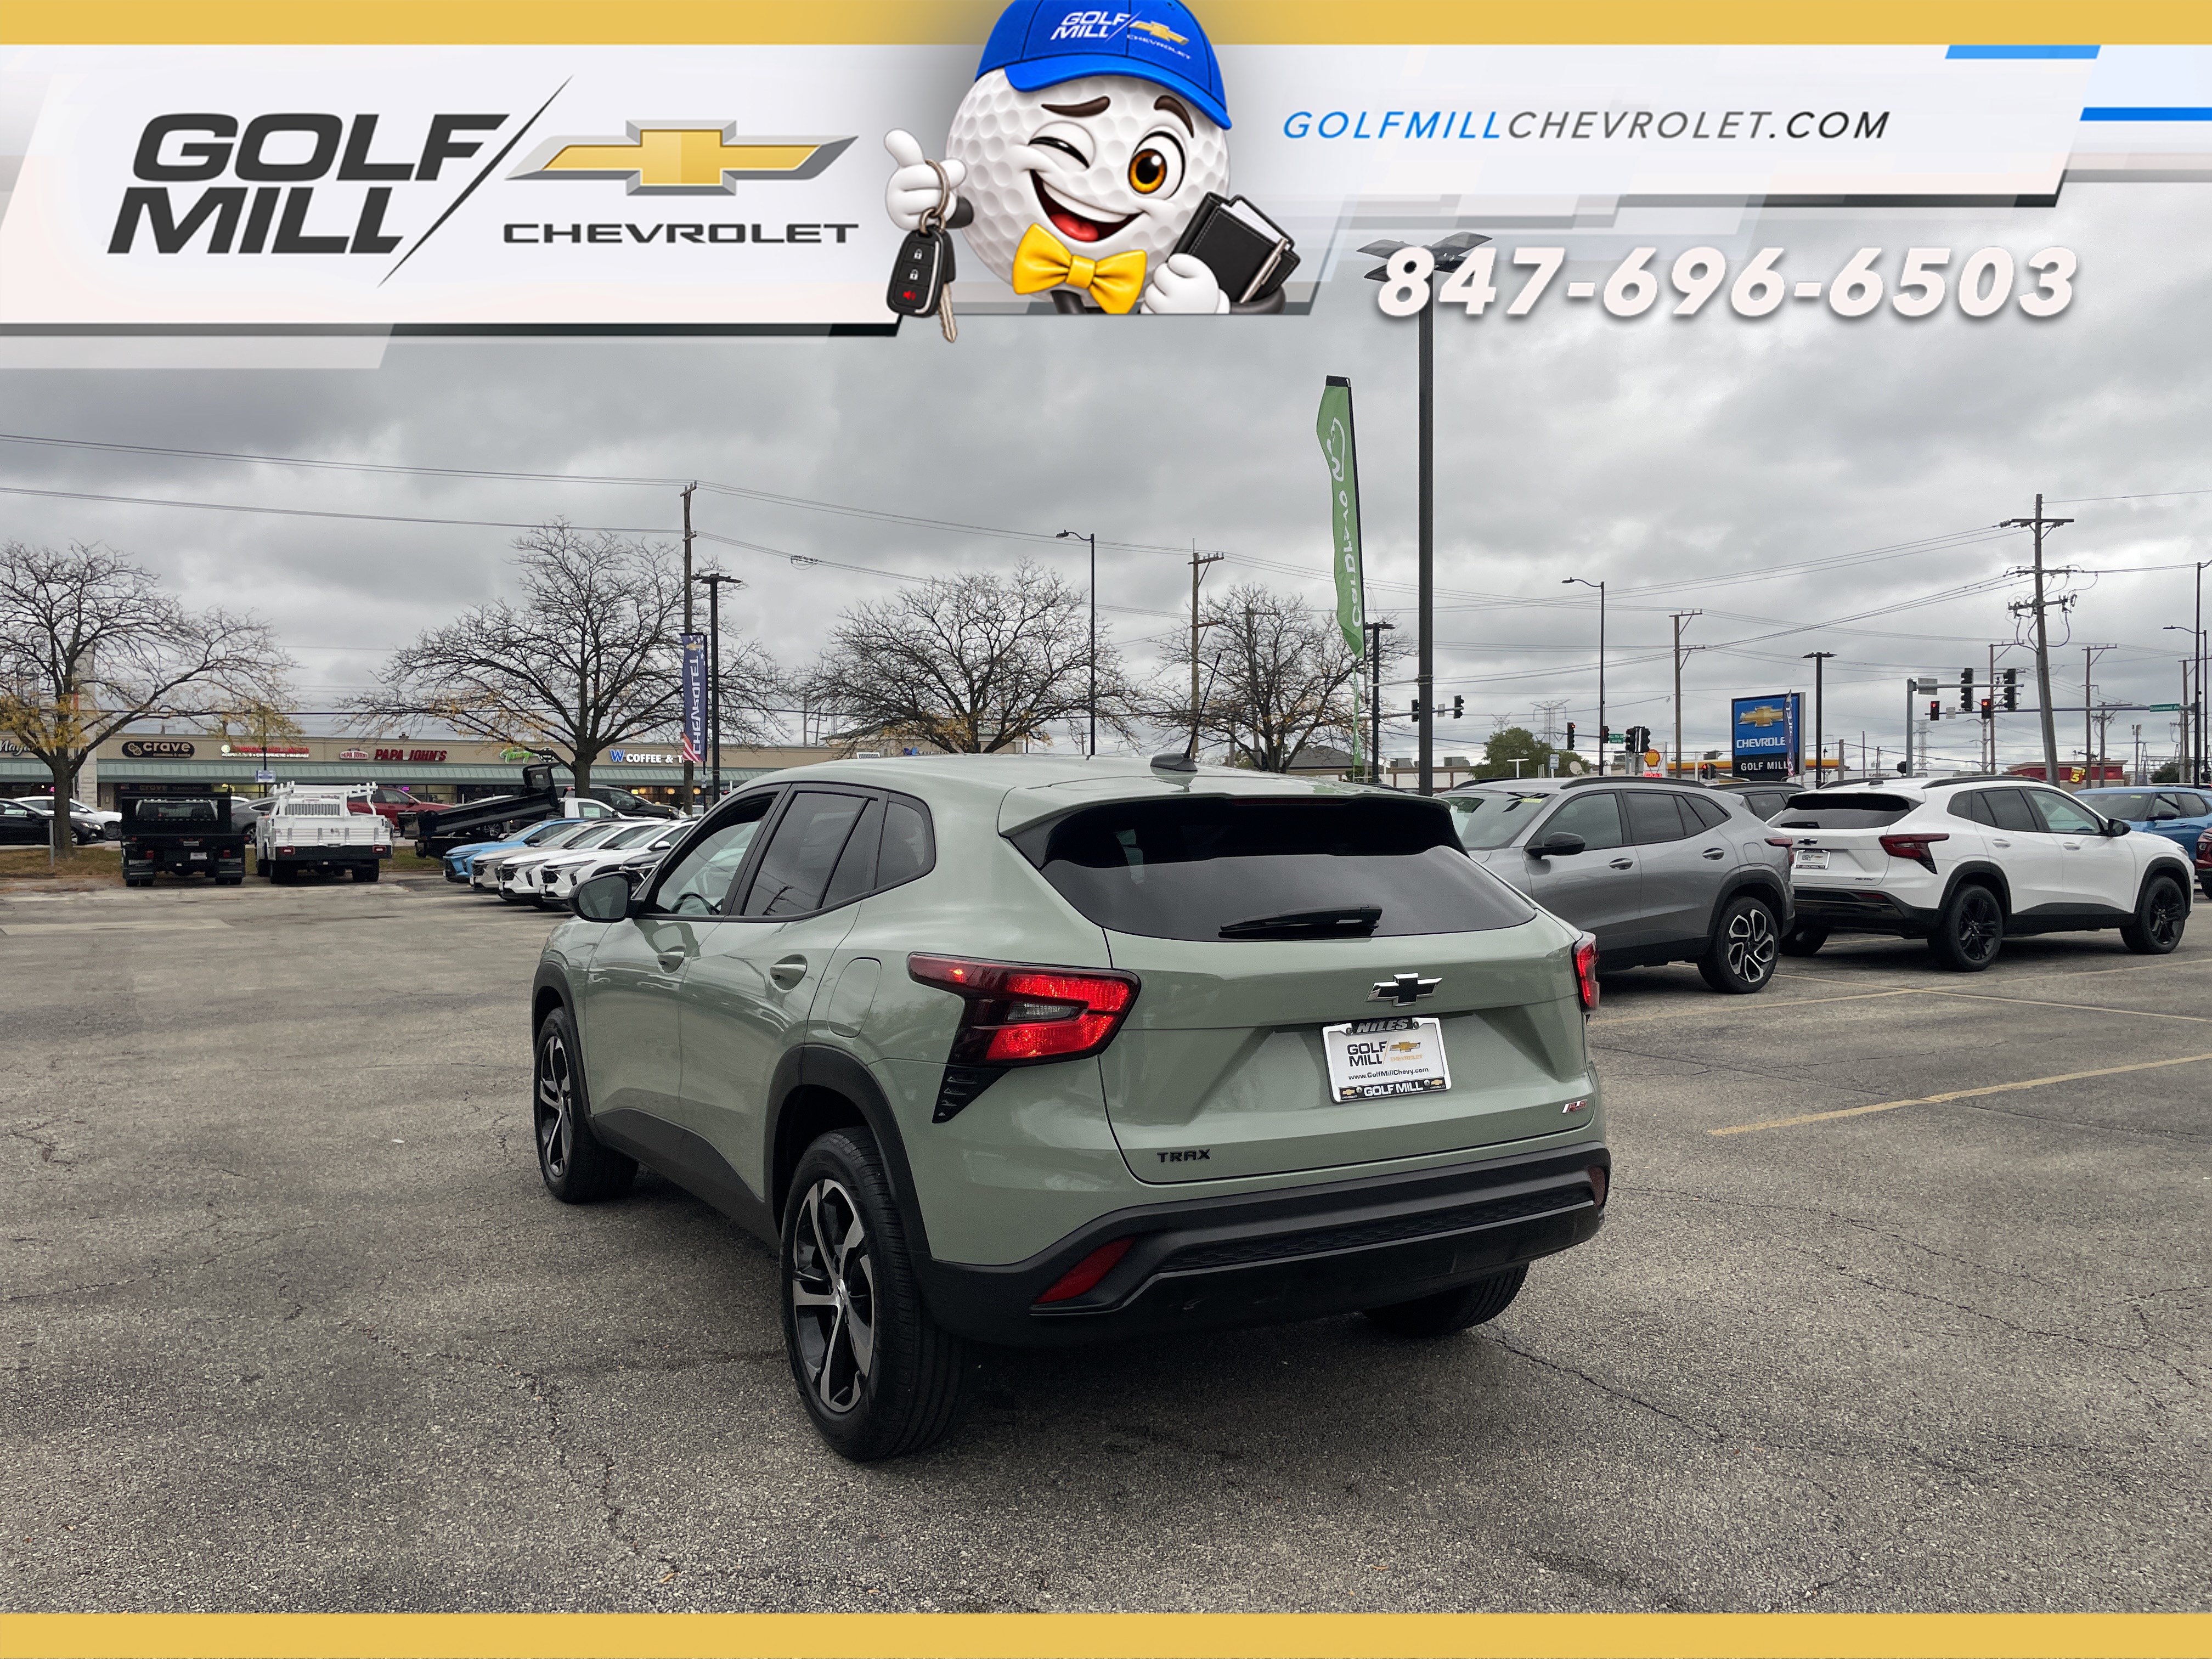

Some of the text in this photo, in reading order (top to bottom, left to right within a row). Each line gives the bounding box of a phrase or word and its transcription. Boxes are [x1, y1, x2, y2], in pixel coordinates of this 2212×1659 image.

[143, 742, 191, 752] crave
[1736, 736, 1786, 748] CHEVROLE
[374, 749, 447, 761] PAPA JOHN'S
[626, 753, 662, 763] COFFEE
[665, 754, 674, 764] &
[1741, 761, 1789, 771] GOLF MILL
[1356, 1019, 1409, 1033] NILES
[1347, 1041, 1387, 1056] GOLF
[1348, 1053, 1383, 1067] MILL
[1390, 1054, 1423, 1062] CHEVROLET
[1348, 1067, 1429, 1080] www.GolfMillChevy.com
[1364, 1081, 1424, 1097] GOLF MILL
[1156, 1148, 1211, 1163] TRAX
